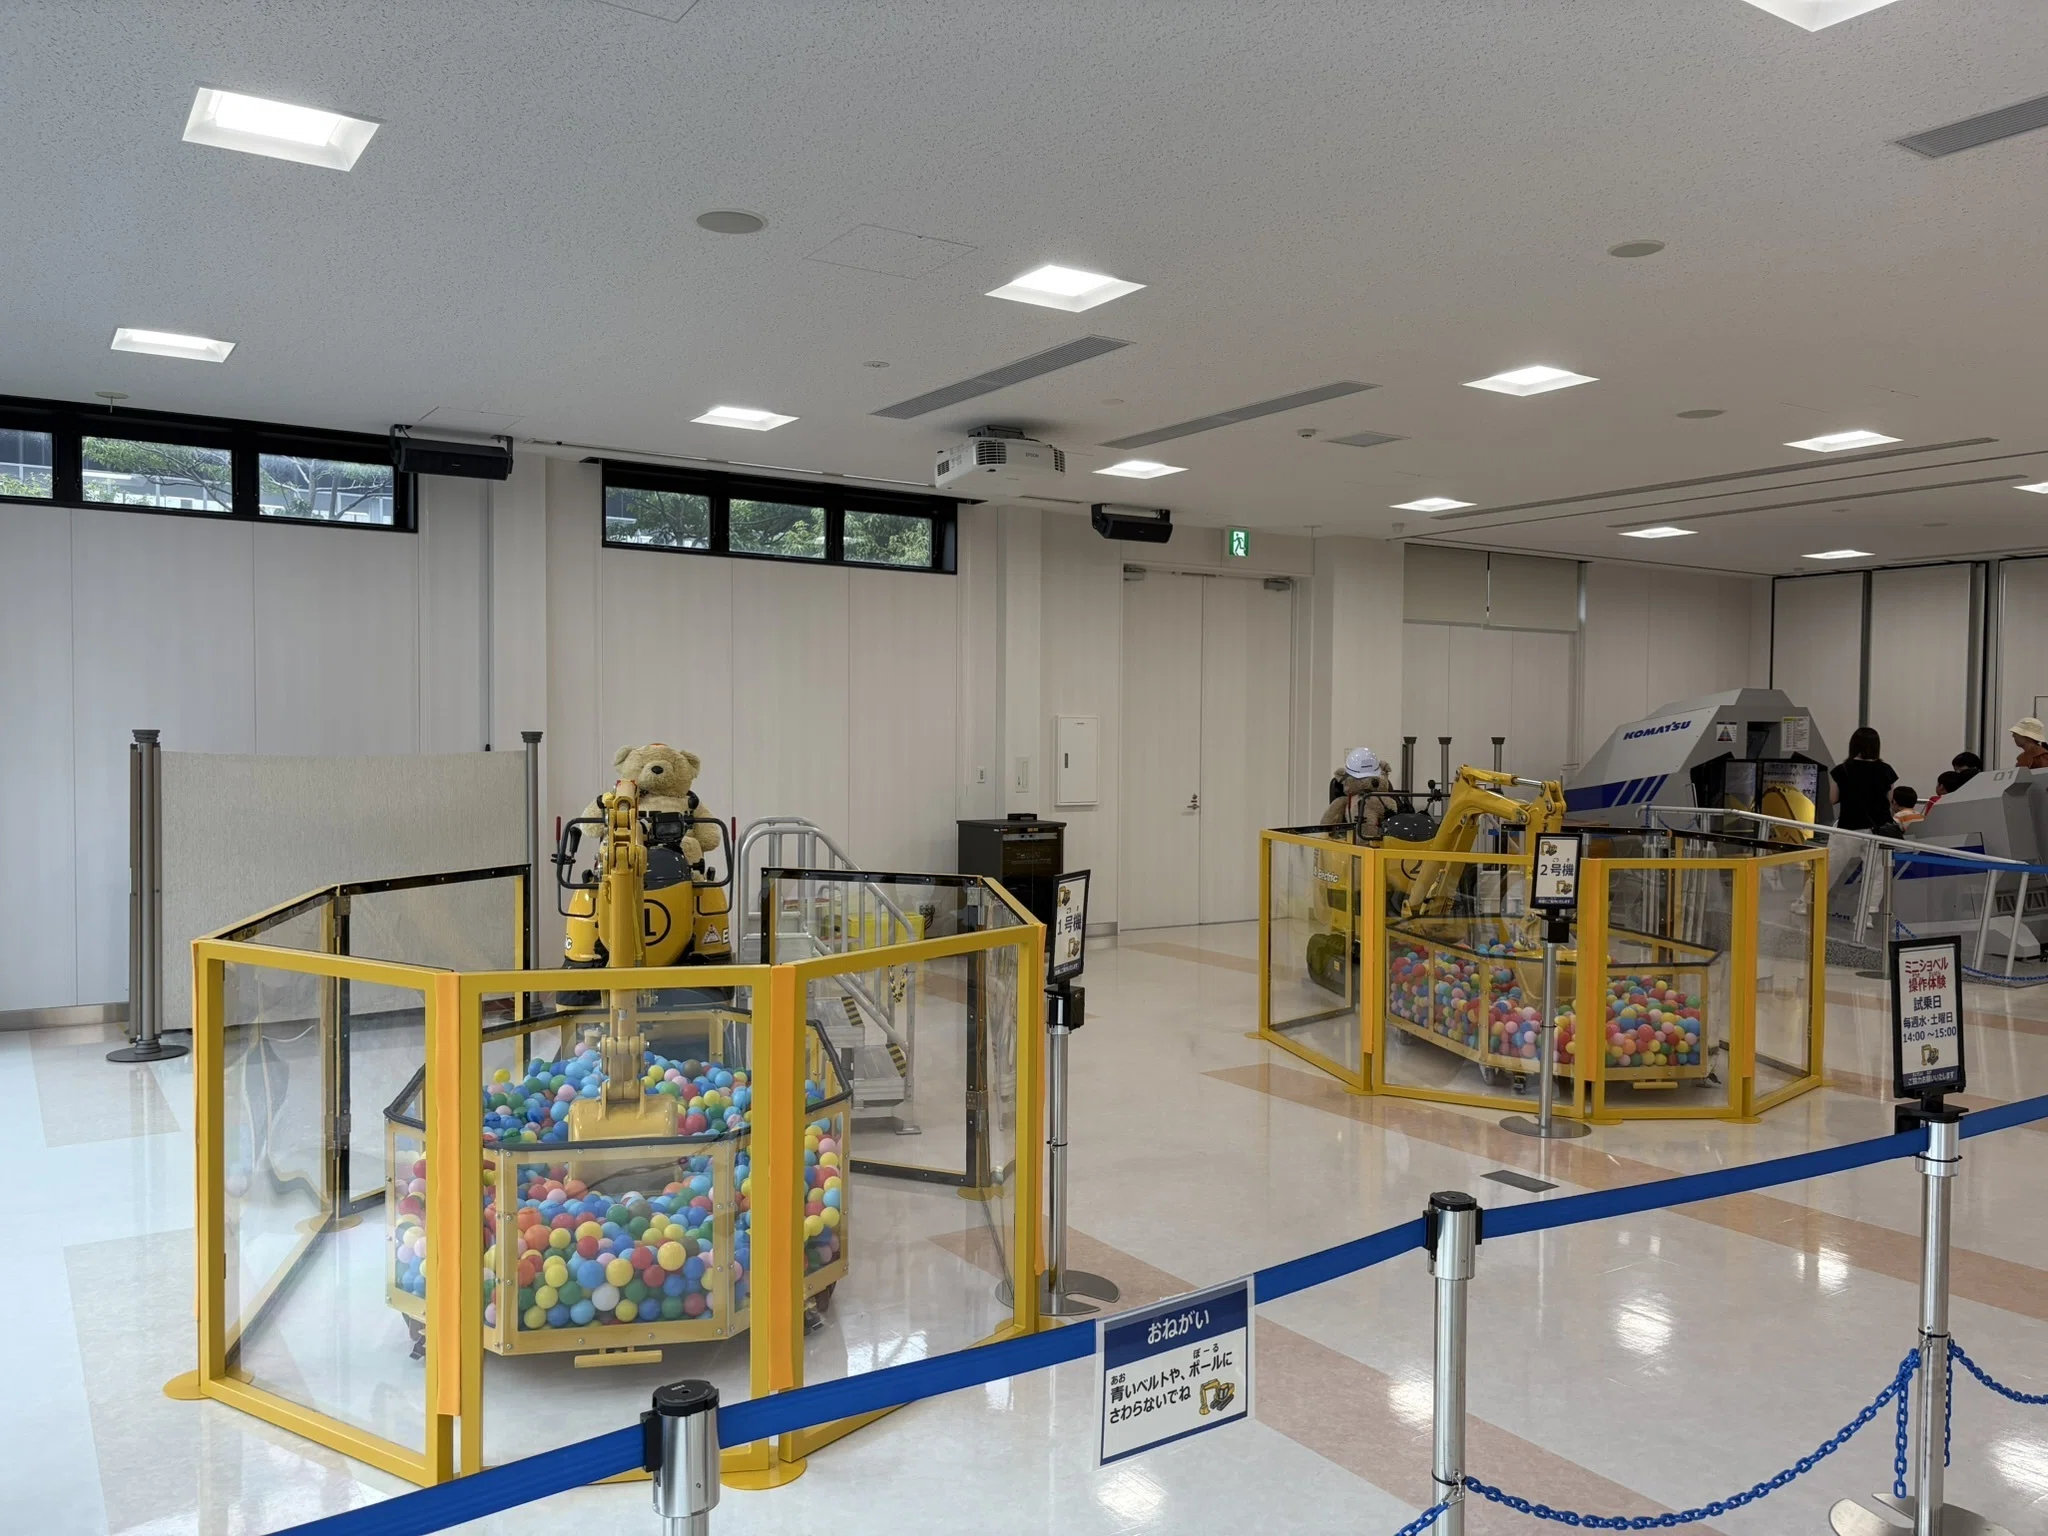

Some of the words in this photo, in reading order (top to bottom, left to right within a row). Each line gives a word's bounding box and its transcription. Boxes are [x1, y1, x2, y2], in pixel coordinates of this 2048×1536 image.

[1623, 720, 1692, 740] KOMATSU
[1540, 863, 1575, 877] 2号機
[1057, 912, 1082, 936] 1号機
[1905, 956, 1949, 973] ミニショベル
[1908, 974, 1947, 993] 操作体験
[1913, 994, 1942, 1011] 試乗日
[1147, 1310, 1210, 1345] おねがい
[1110, 1351, 1233, 1404] 青いベルトや、ボールに
[1110, 1373, 1126, 1385] あお
[1109, 1385, 1192, 1424] さわらないでね
